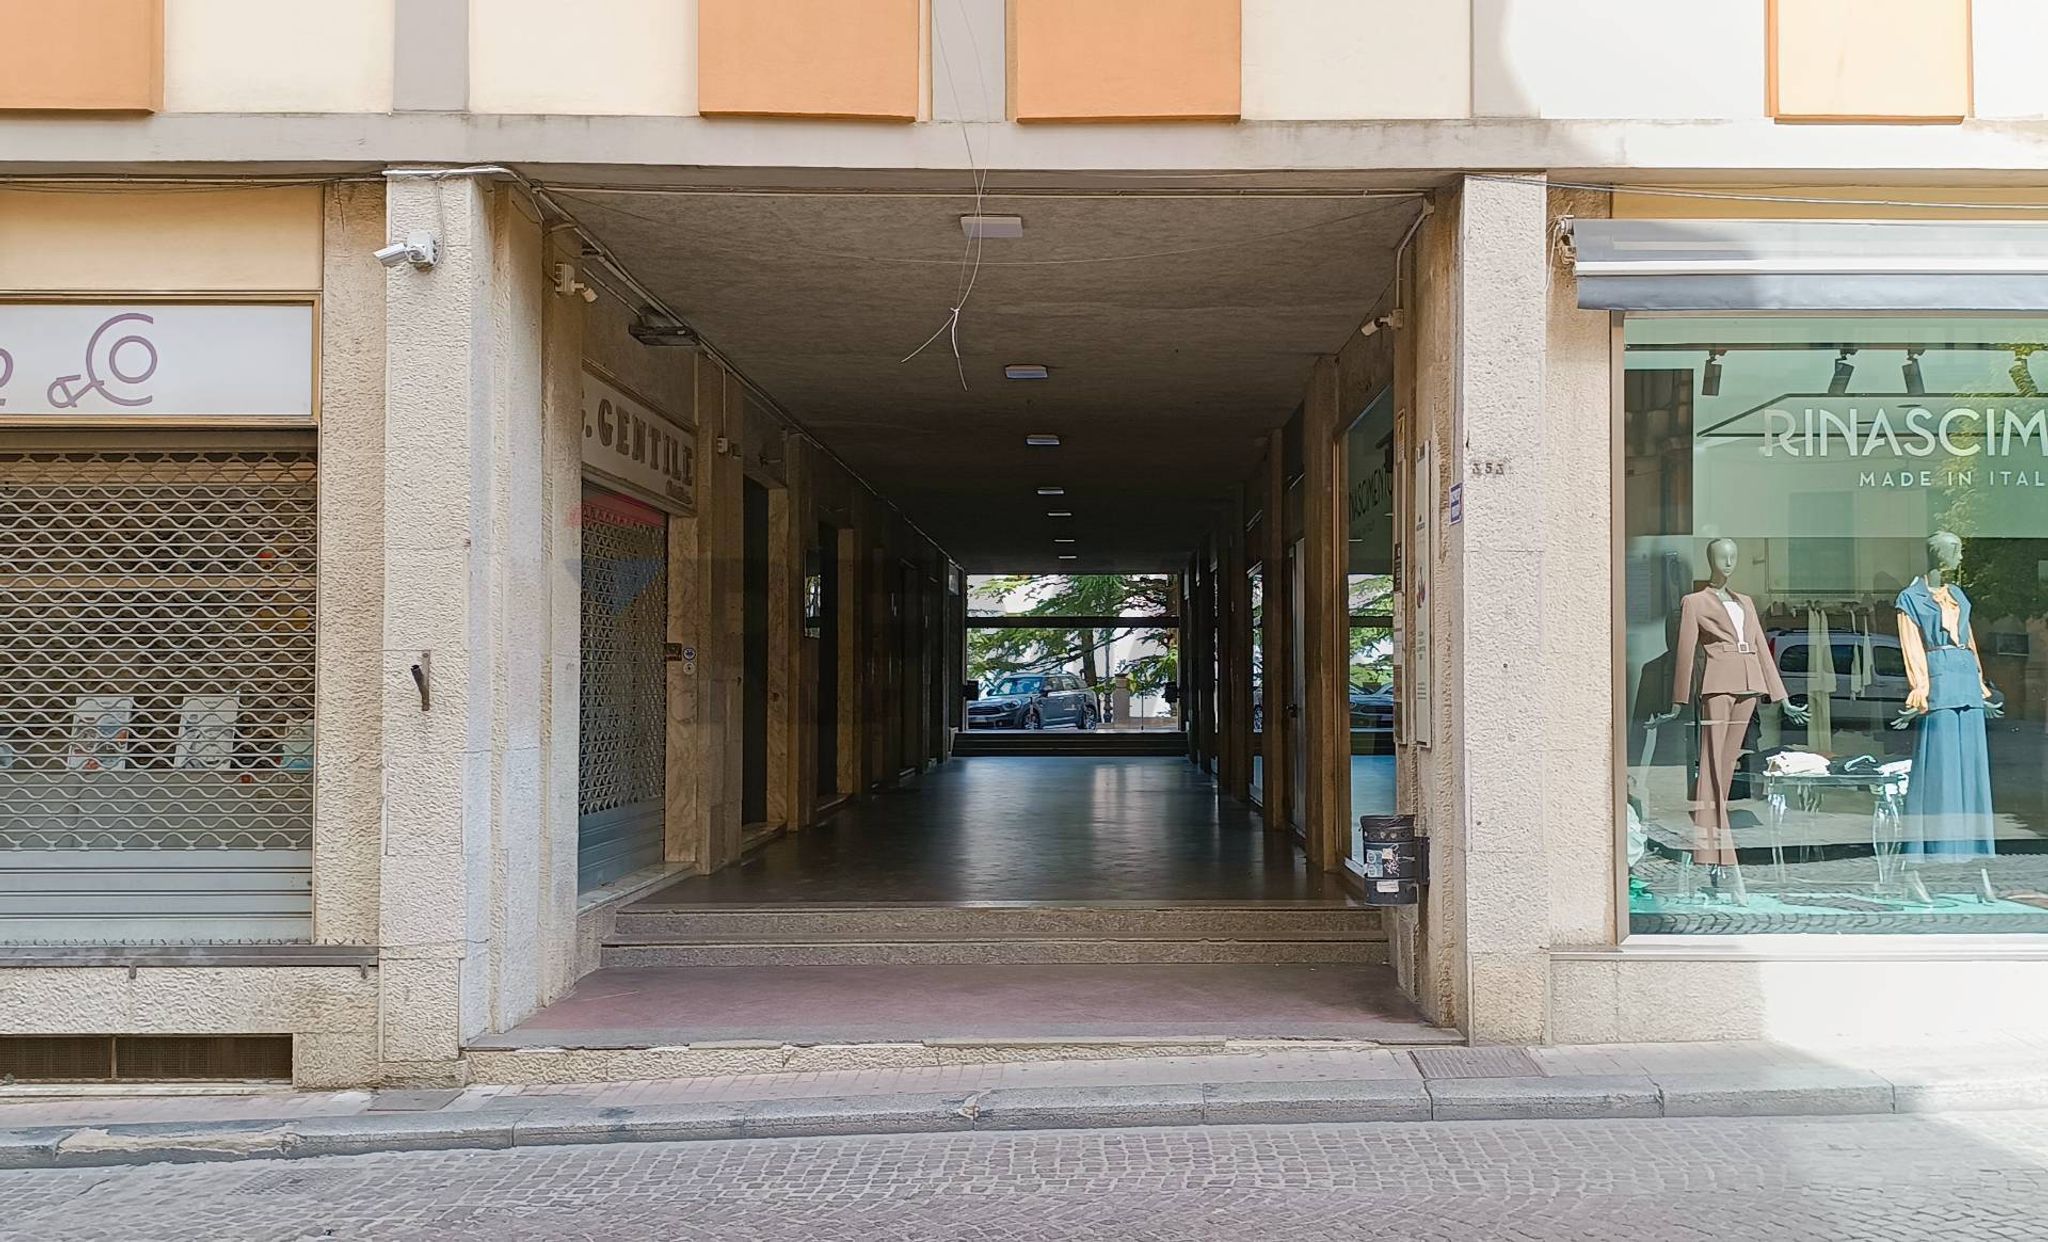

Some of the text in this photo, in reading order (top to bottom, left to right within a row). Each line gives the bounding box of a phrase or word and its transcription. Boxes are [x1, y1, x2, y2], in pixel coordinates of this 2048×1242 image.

[1763, 408, 2048, 457] RINASCIM
[1859, 470, 1932, 487] MADE
[1947, 470, 1973, 487] IN
